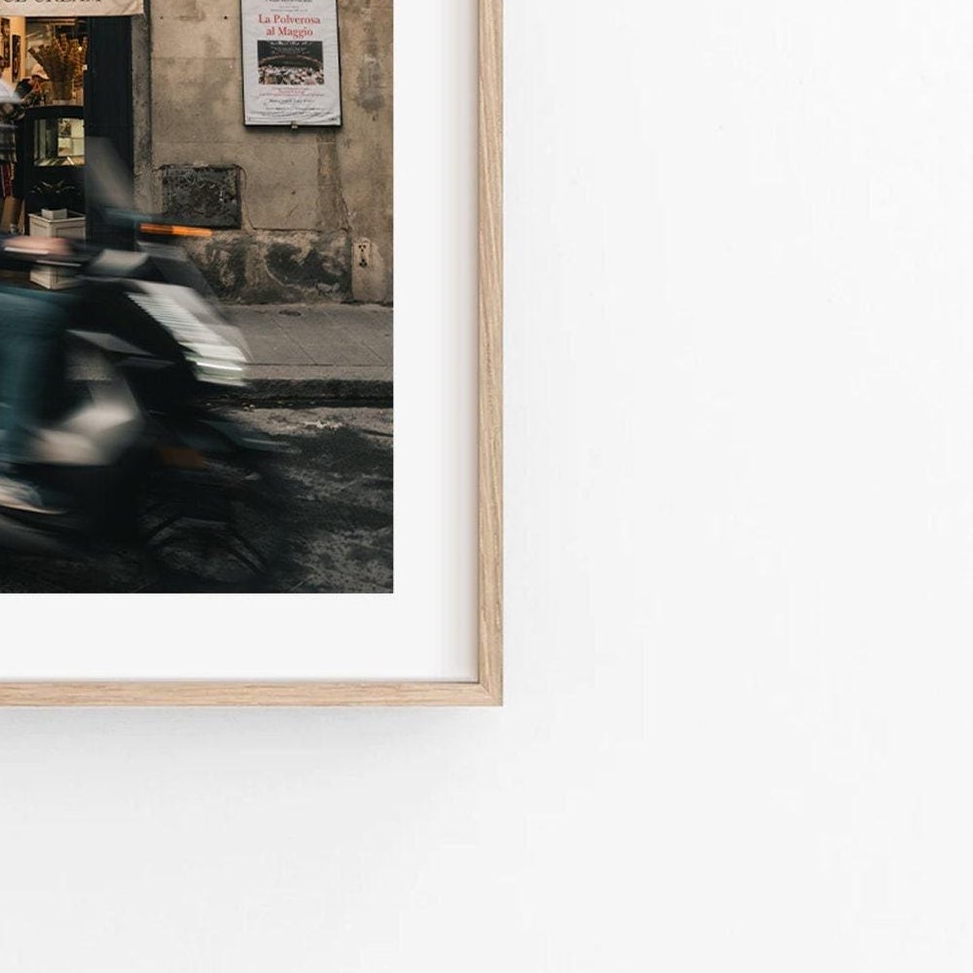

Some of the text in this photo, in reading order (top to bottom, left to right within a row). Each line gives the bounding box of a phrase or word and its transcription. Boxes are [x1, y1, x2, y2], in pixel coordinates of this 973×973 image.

[258, 14, 321, 25] La Polverosa
[266, 27, 314, 39] al Maggio
